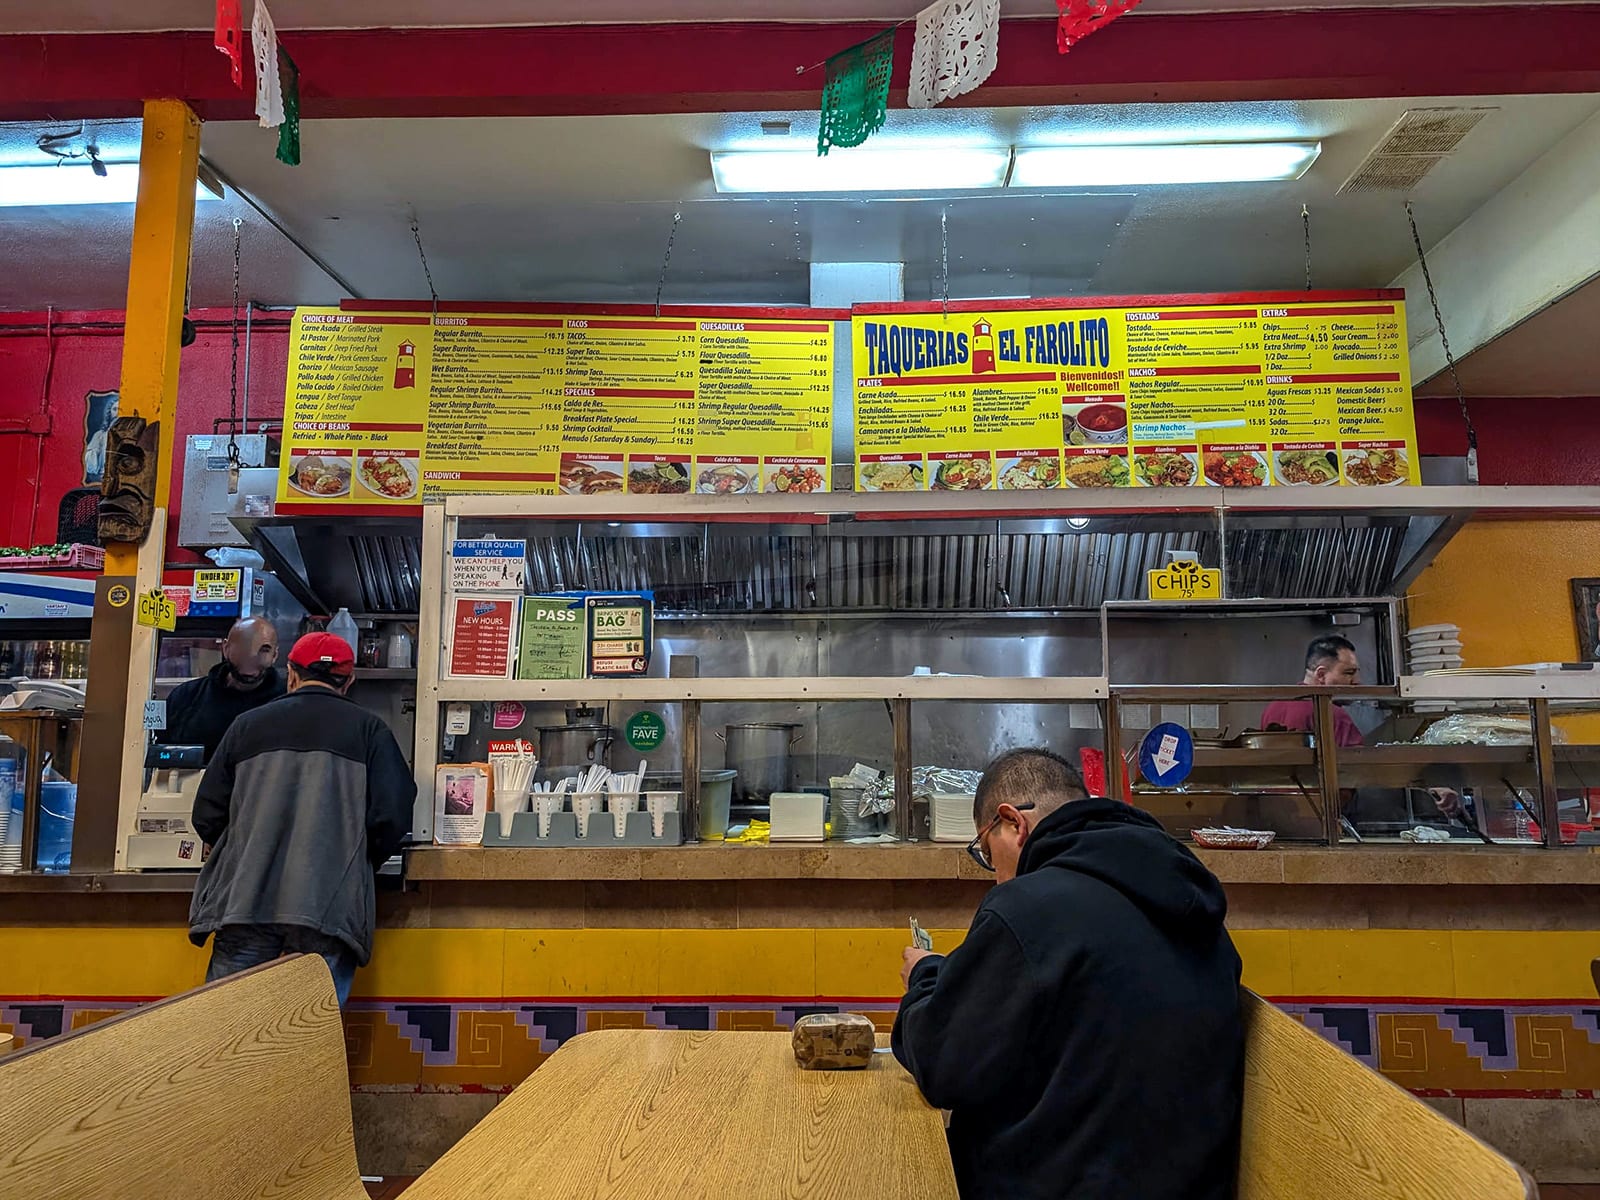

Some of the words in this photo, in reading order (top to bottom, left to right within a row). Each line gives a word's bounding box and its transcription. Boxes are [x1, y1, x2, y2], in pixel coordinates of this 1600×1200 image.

[1262, 309, 1288, 317] EXTRAS
[302, 315, 326, 323] CHOICE
[435, 318, 468, 326] BURRITOS
[301, 324, 320, 332] Carne
[700, 323, 744, 331] QUESADILLAS
[308, 334, 329, 342] Pastor
[434, 330, 459, 338] Regular
[433, 345, 452, 353] Super
[864, 322, 968, 378] TAQUERIAS
[999, 329, 1020, 362] EL
[1025, 317, 1109, 368] FAROLITO
[566, 348, 584, 356] Super
[566, 368, 588, 376] Shrimp
[1060, 370, 1124, 381] Bienvenidos!!
[1066, 381, 1119, 392] Wellcome!!
[296, 393, 319, 401] Lengua
[858, 391, 877, 399] Carne
[295, 402, 318, 410] Cabeza
[294, 412, 314, 421] Tripas
[294, 422, 317, 430] CHOICE
[318, 422, 327, 430] OF
[1134, 424, 1159, 433] Shrimp
[1160, 423, 1186, 431] Nachos
[292, 432, 316, 440] Refried
[424, 472, 460, 480] SANDWICH
[1157, 574, 1210, 589] CHIPS
[142, 600, 170, 619] CHIPS
[536, 610, 576, 621] PASS
[597, 616, 625, 626] BAG
[633, 730, 658, 739] FAVE
